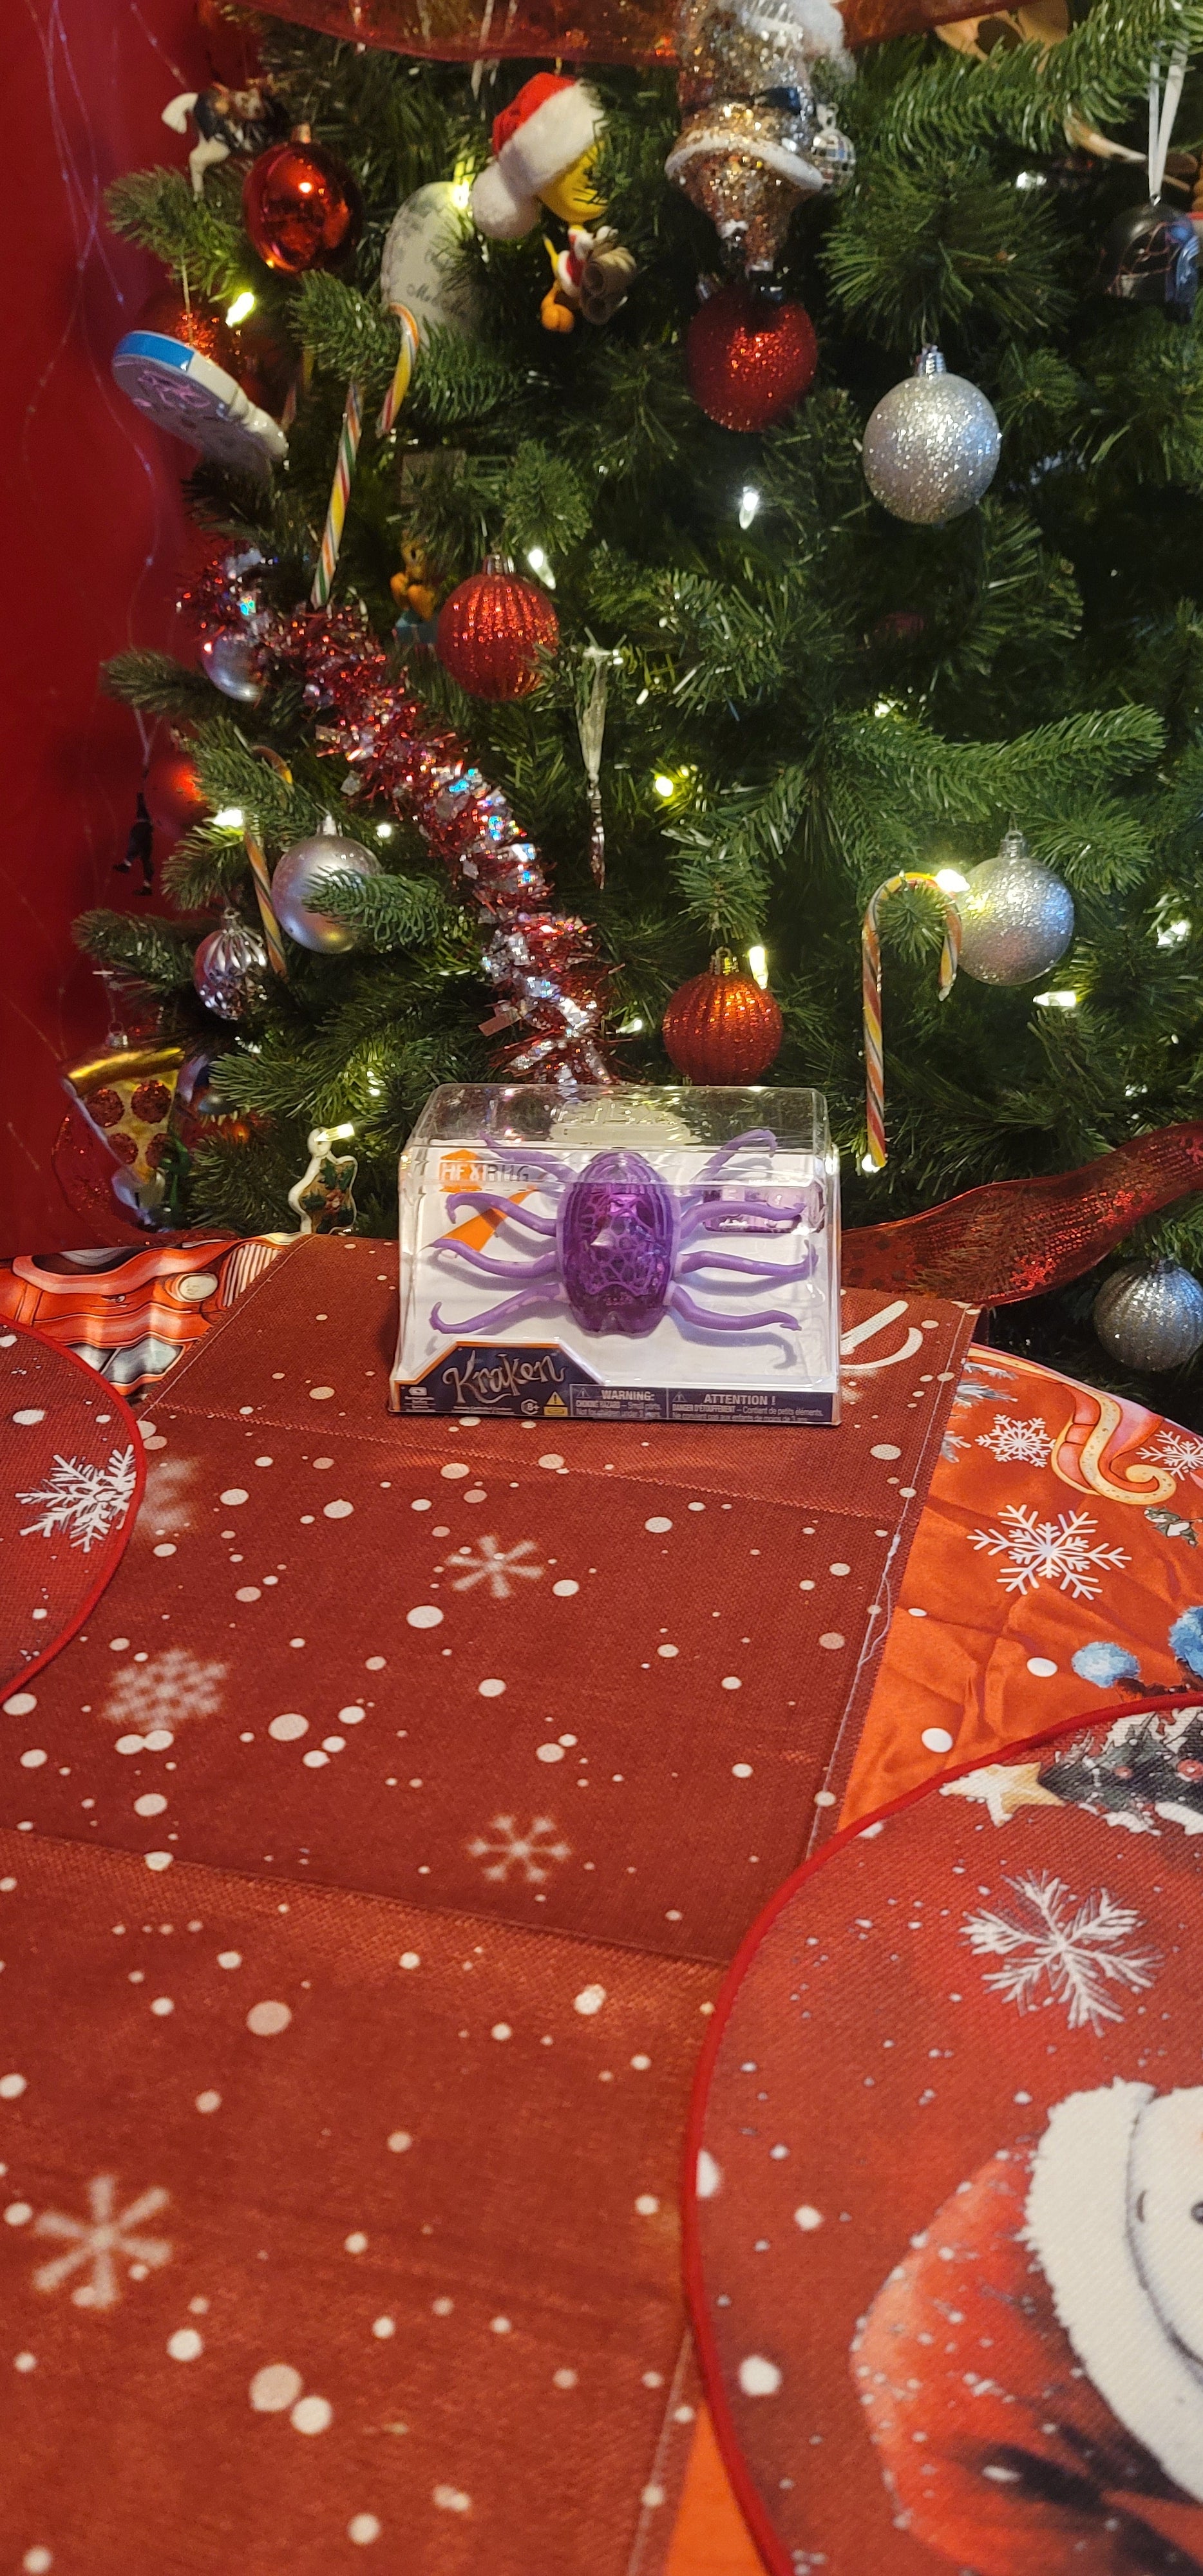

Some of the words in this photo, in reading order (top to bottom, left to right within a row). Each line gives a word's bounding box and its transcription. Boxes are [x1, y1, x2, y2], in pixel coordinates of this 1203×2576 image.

[442, 1349, 568, 1404] Kraken
[601, 1389, 655, 1401] WARNING:
[703, 1394, 768, 1405] ATTENTION
[627, 1401, 645, 1410] Small
[672, 1403, 694, 1412] DANGER
[743, 1405, 768, 1414] Contient
[777, 1407, 794, 1416] petits
[795, 1408, 824, 1416] éléments.
